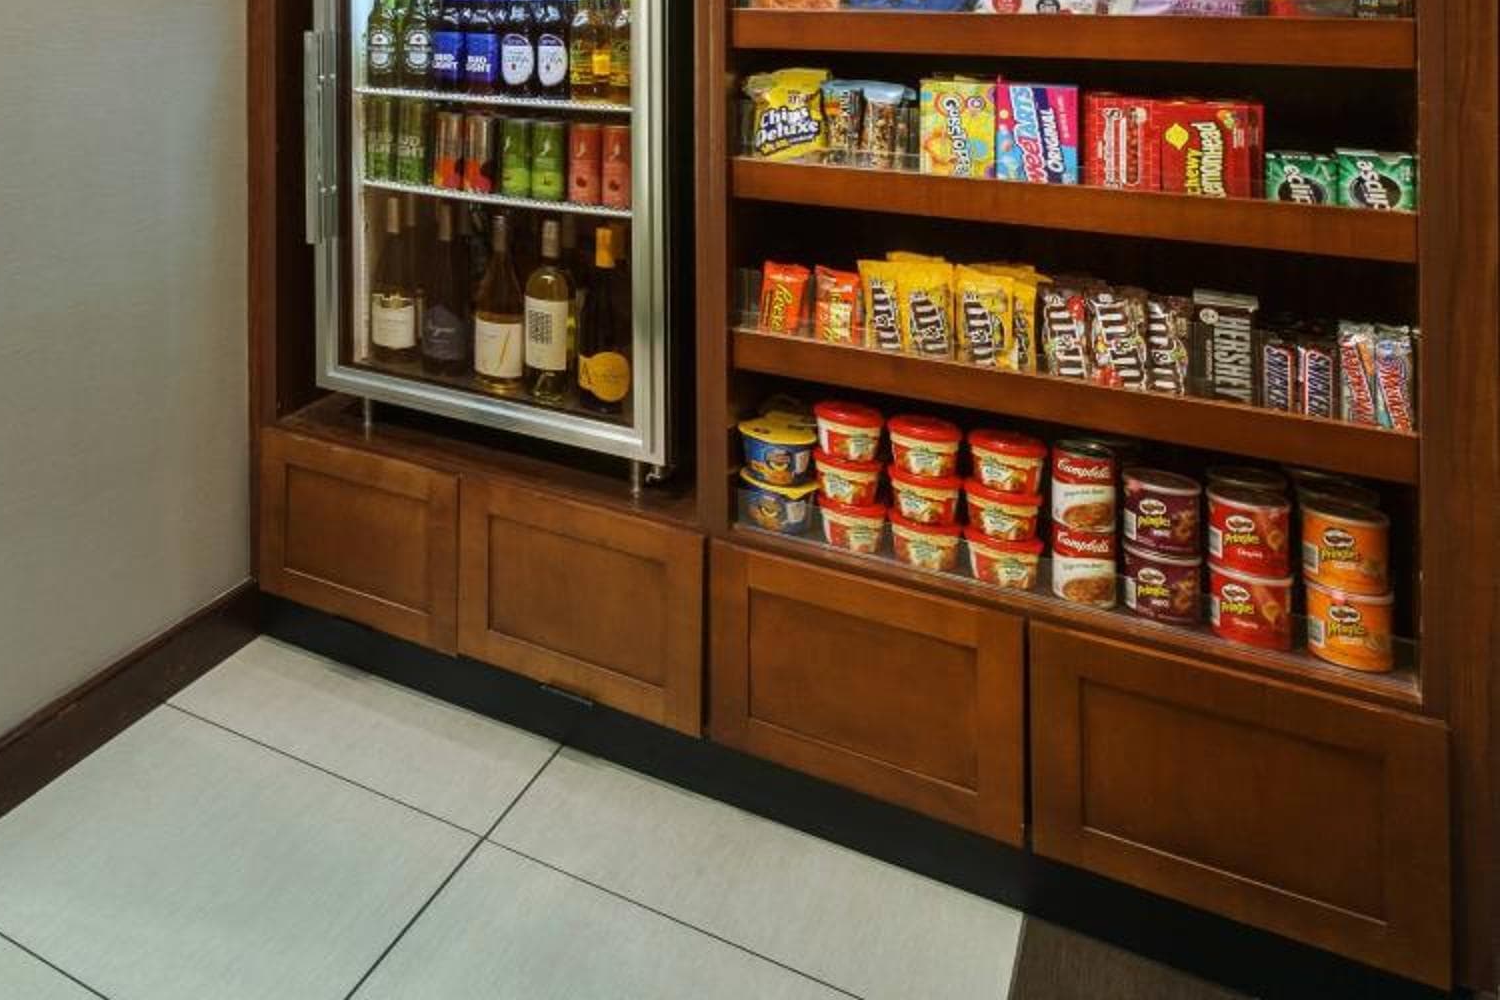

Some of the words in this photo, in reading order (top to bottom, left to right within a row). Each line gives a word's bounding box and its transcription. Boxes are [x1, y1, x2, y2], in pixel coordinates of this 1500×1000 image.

[761, 106, 810, 128] Chips
[755, 119, 819, 148] Deluxe
[1213, 314, 1252, 399] HERSHEY
